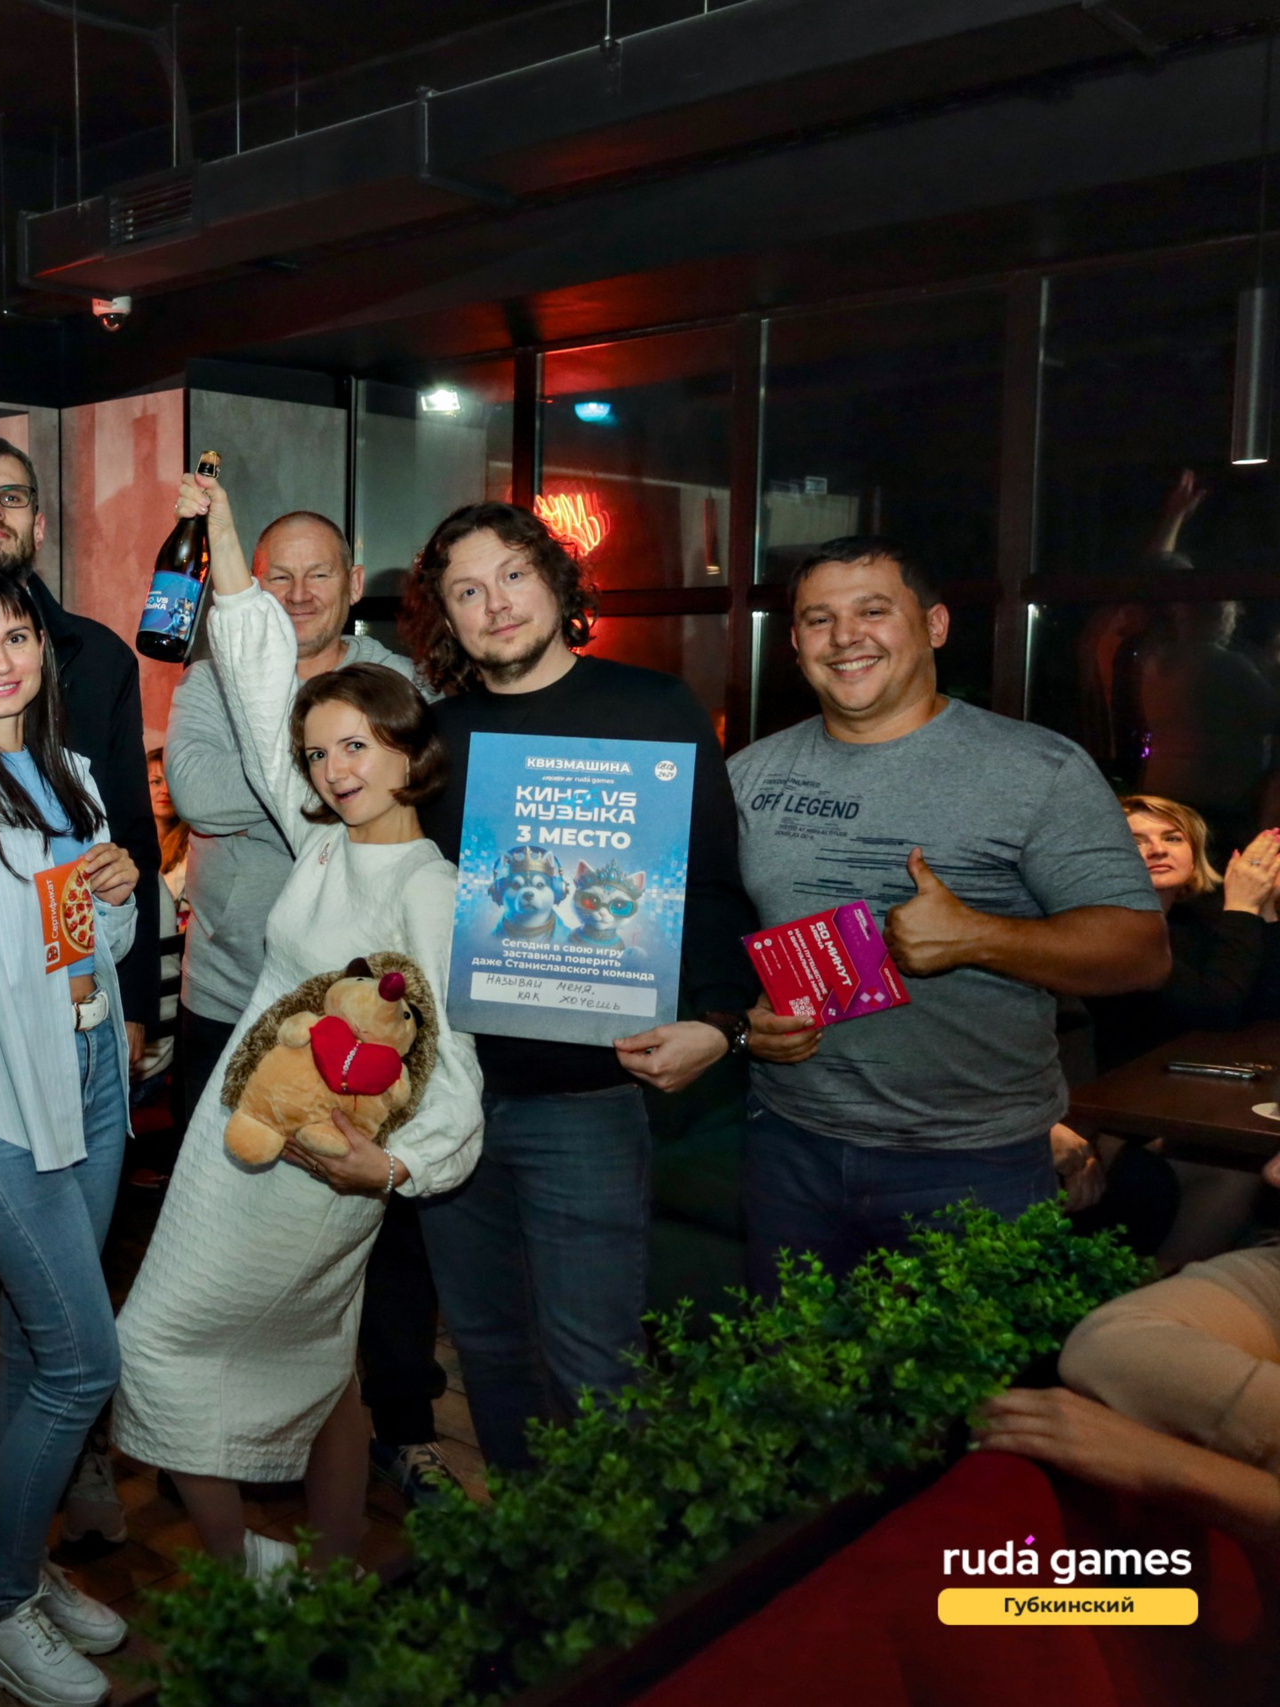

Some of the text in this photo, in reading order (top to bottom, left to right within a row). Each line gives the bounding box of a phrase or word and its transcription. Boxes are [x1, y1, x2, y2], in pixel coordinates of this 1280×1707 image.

[528, 758, 630, 773] КВИЗМАШИНА
[601, 790, 637, 808] VS
[751, 793, 859, 819] OFF LEGEND
[515, 802, 635, 824] МУЗЫКА
[517, 825, 631, 849] 3 МЕСТО
[46, 880, 59, 939] Сертификат
[502, 938, 550, 951] Сегодня
[564, 944, 593, 955] свою
[596, 948, 624, 959] игру
[809, 925, 824, 950] ARENA
[502, 949, 622, 968] заставила поверить
[815, 921, 852, 986] 60 МИНУТ
[471, 957, 655, 981] даже Станиславского команда
